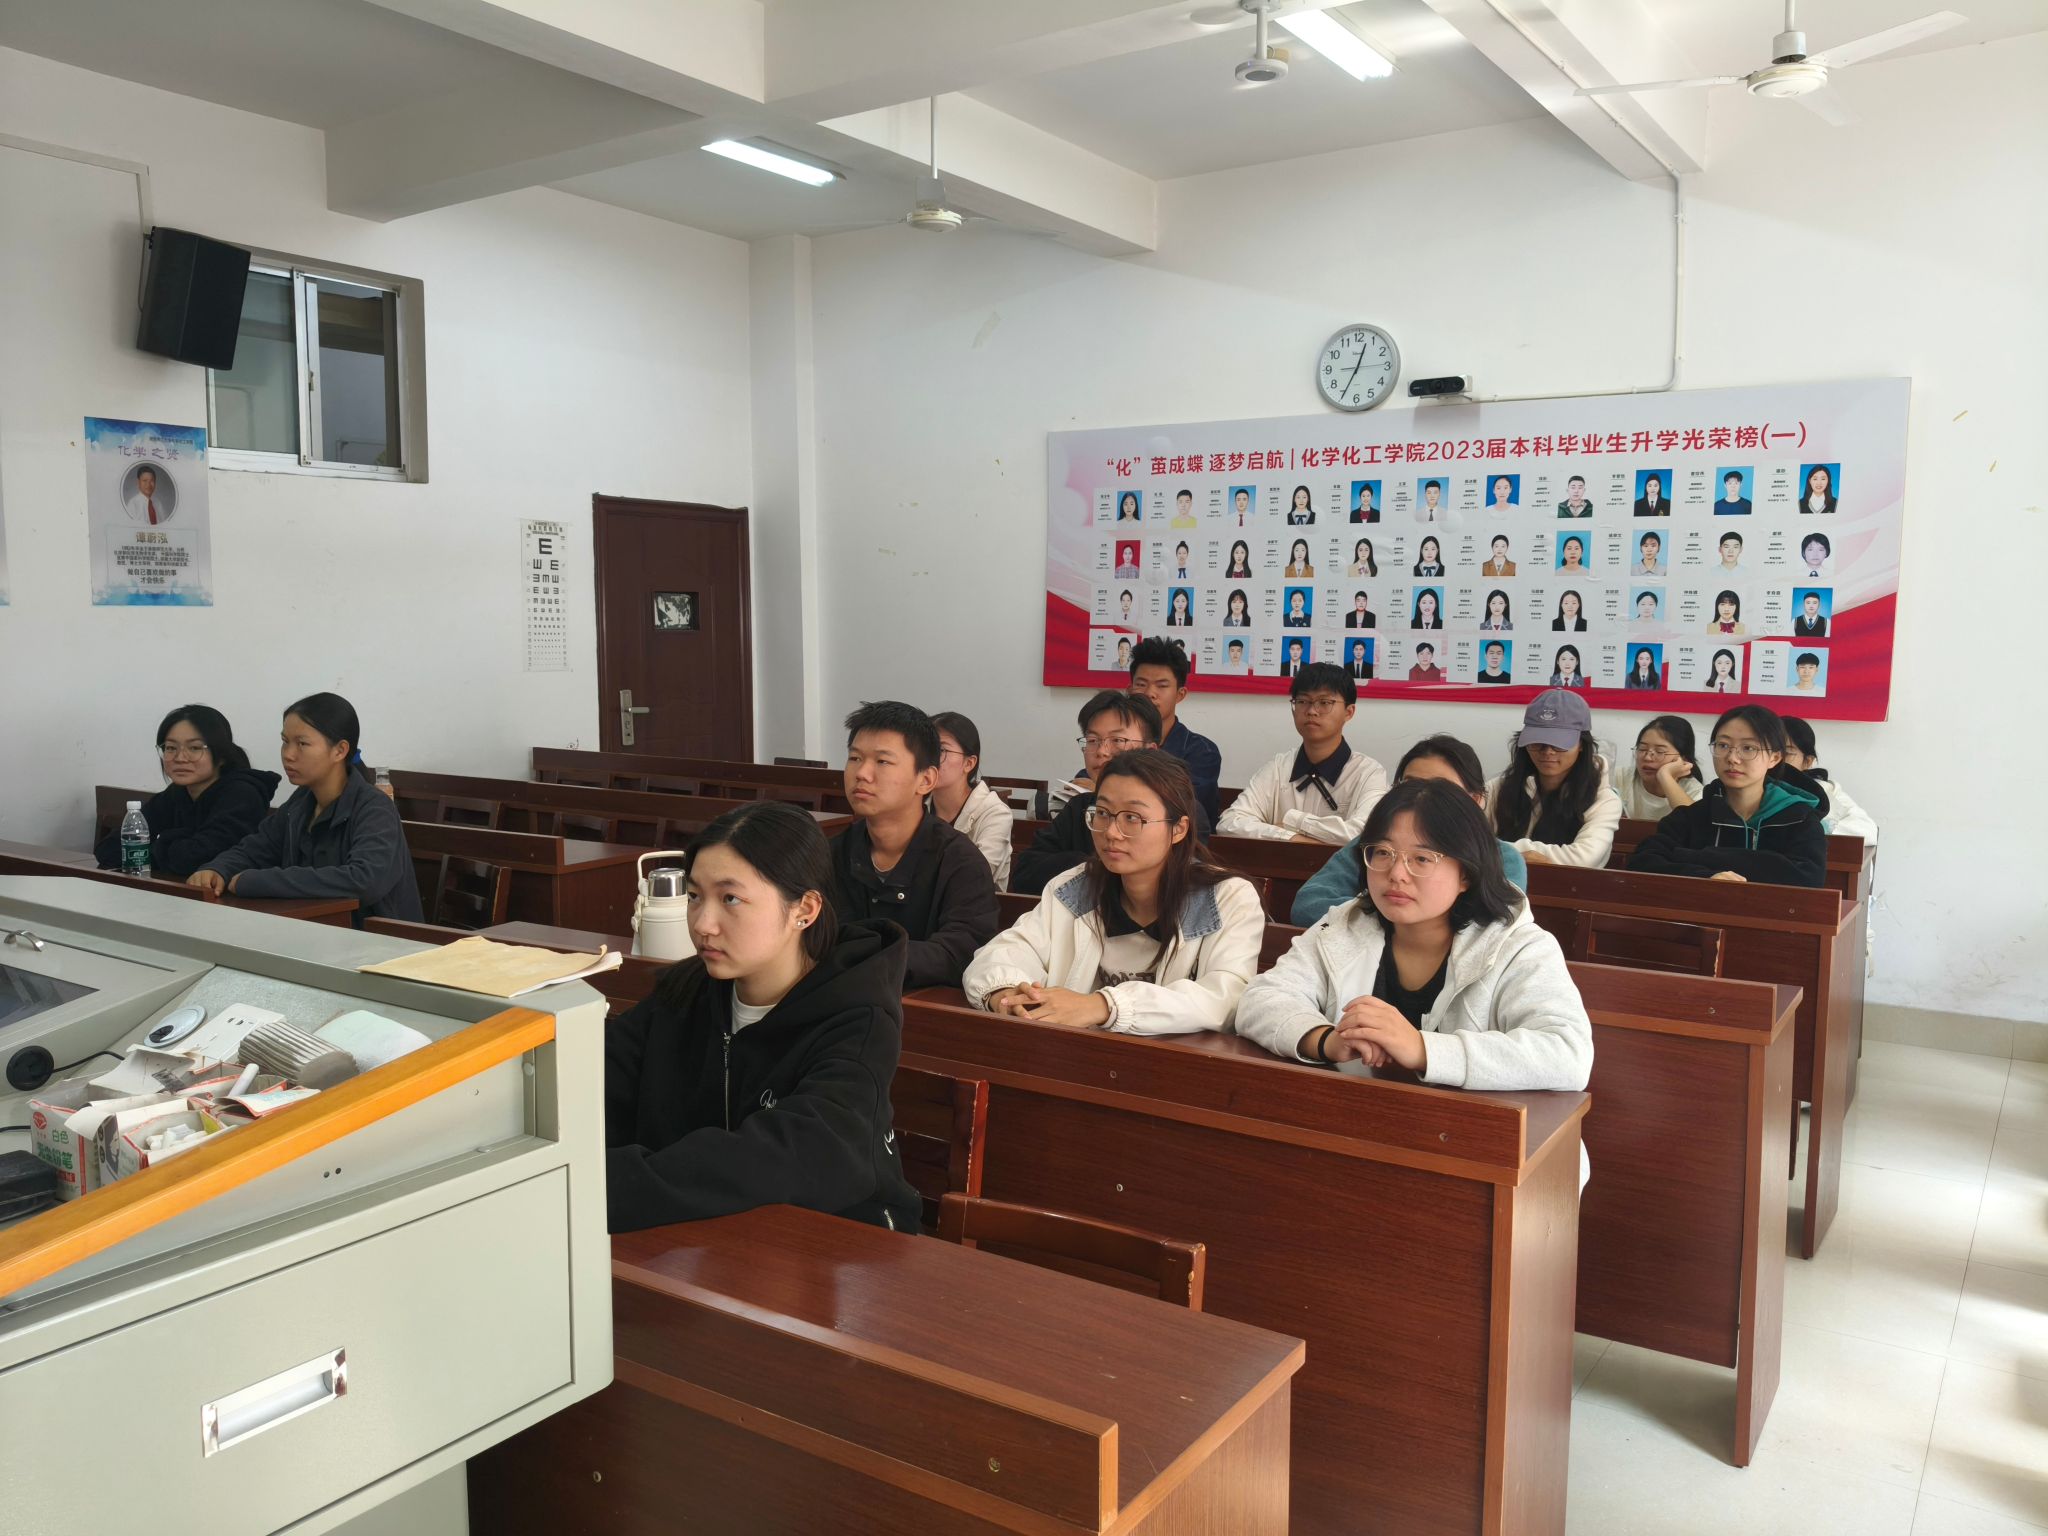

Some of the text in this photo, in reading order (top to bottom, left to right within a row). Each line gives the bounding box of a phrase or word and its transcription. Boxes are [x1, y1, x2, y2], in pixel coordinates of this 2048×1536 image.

[1341, 337, 1350, 348] 11
[1354, 332, 1365, 343] 12
[1329, 349, 1341, 360] 10
[1379, 346, 1387, 357] 2
[1325, 365, 1333, 375] 9
[1384, 361, 1391, 371] 3
[1330, 379, 1338, 389] 8
[1377, 376, 1384, 386] 4
[1353, 393, 1361, 404] 6
[1367, 388, 1375, 398] 5
[51, 1128, 70, 1145] 白色
